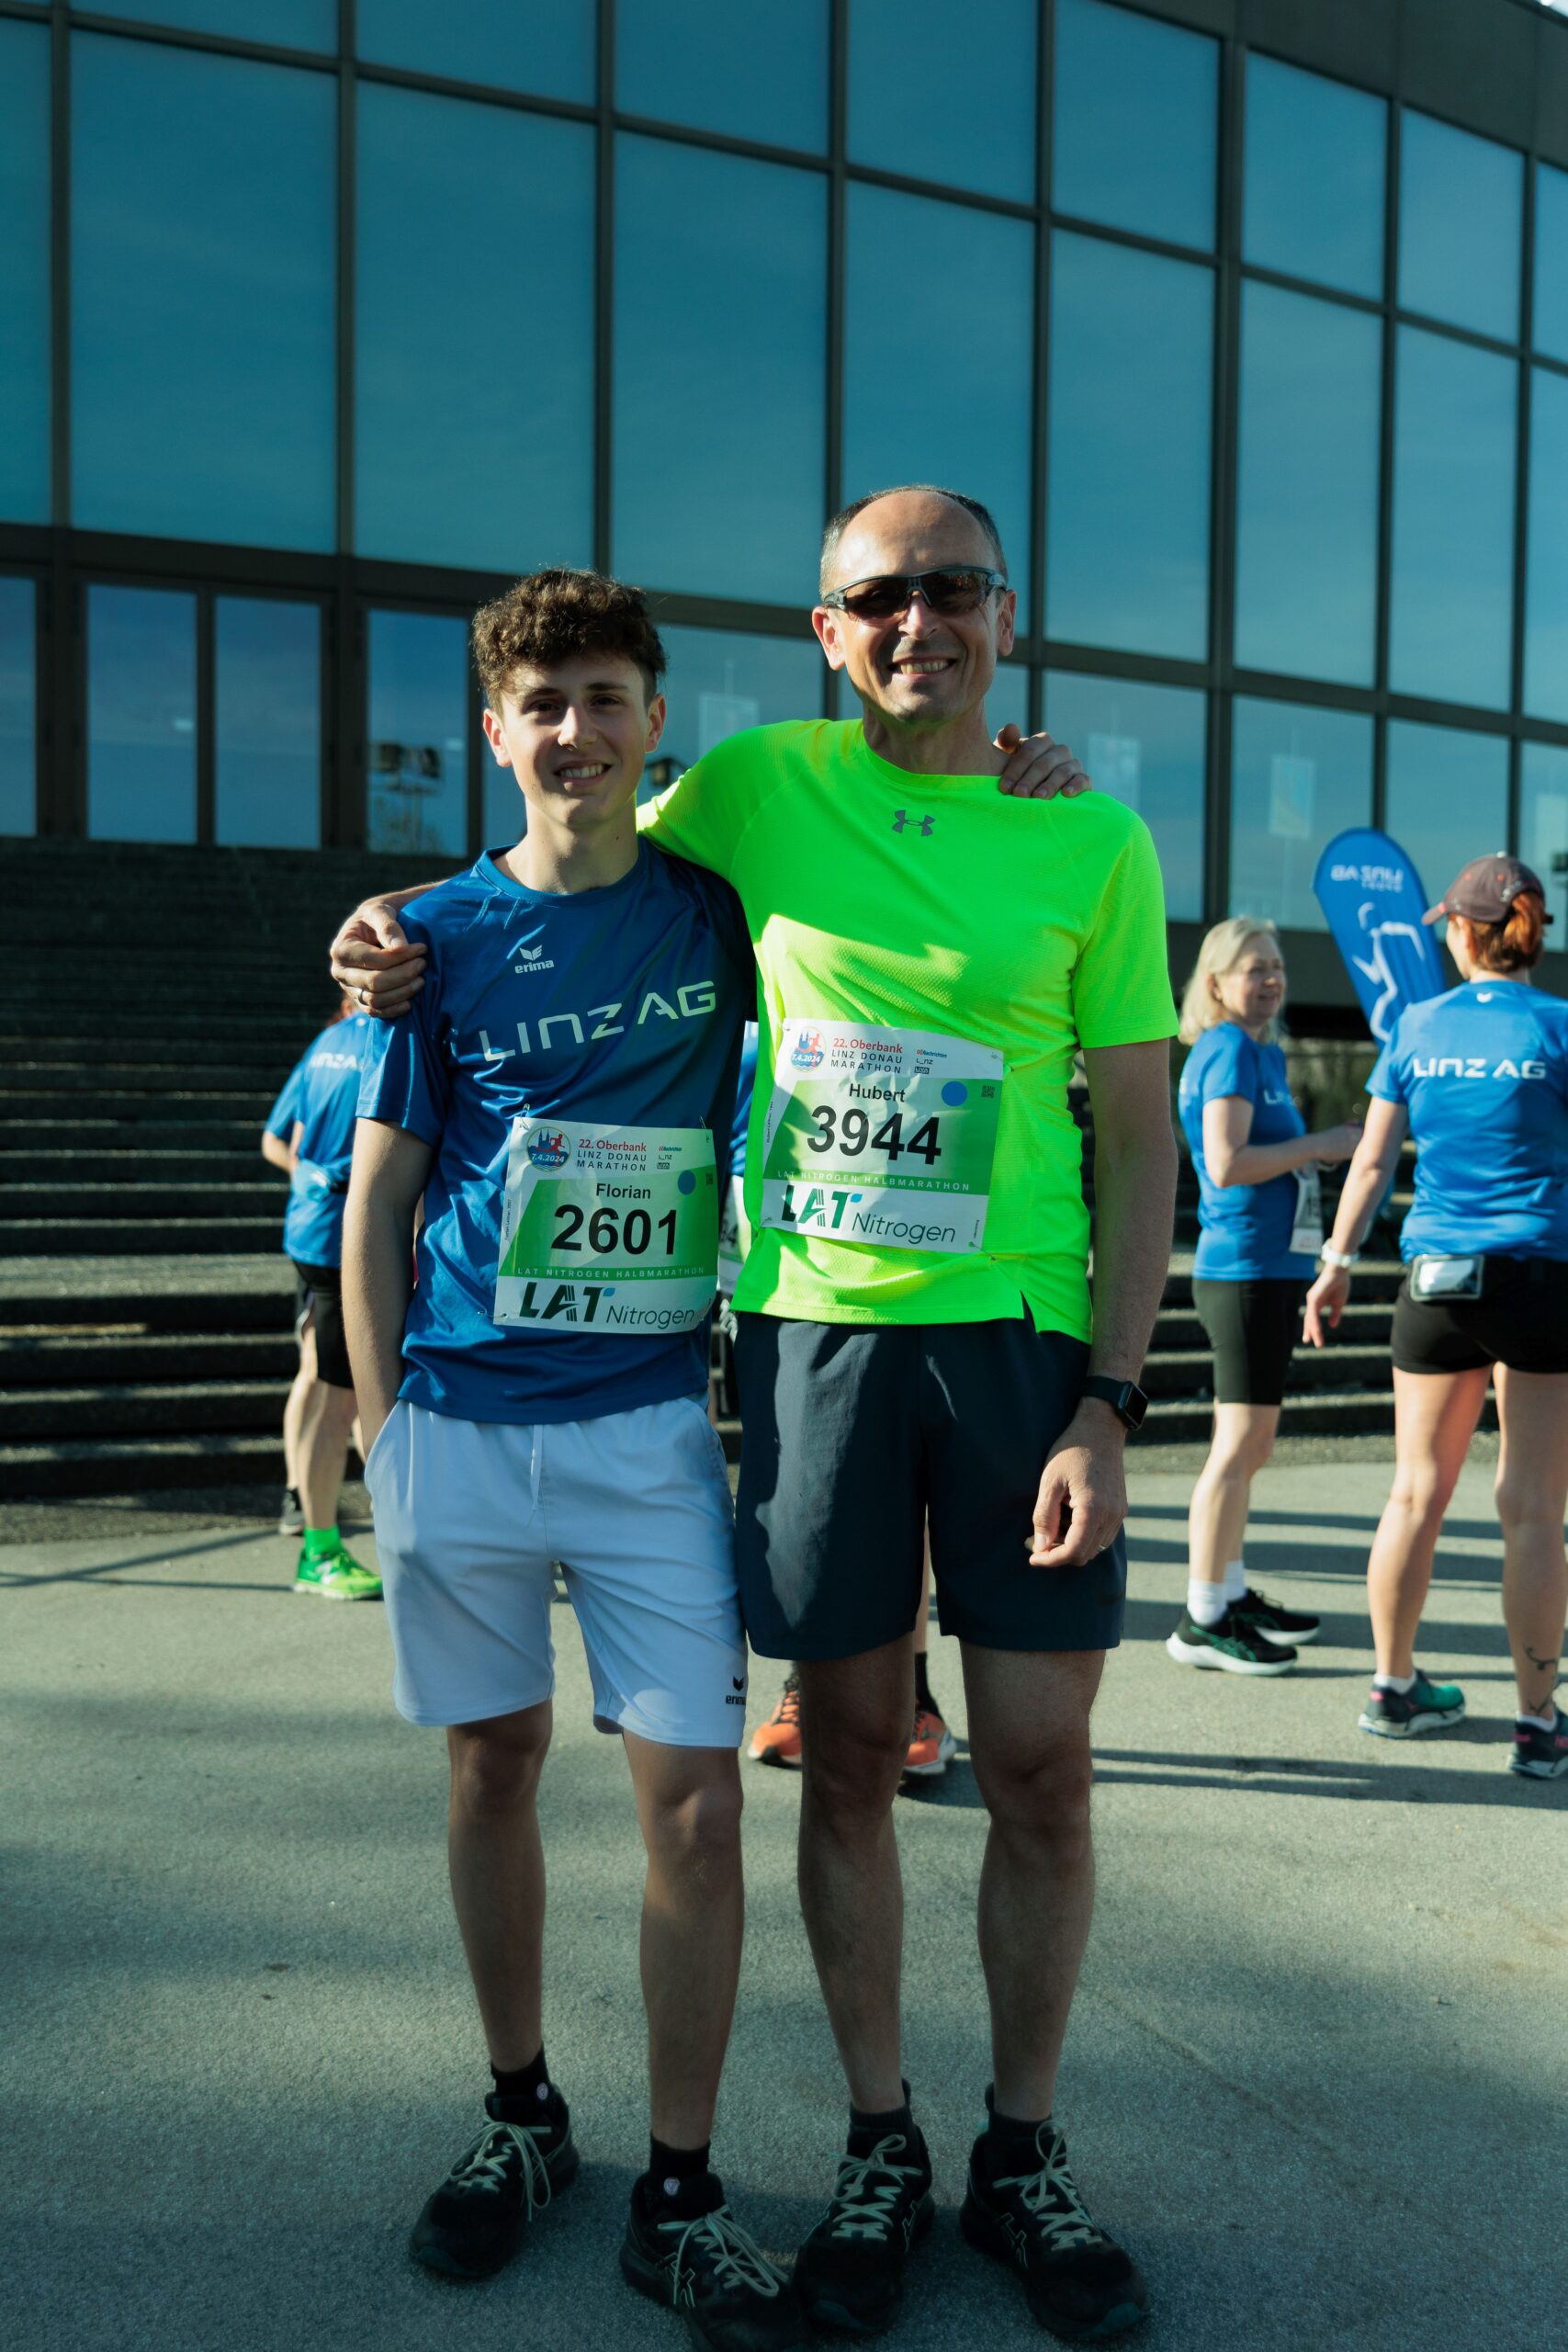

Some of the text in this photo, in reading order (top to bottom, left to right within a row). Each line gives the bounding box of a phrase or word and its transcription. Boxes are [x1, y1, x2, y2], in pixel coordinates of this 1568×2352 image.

[514, 960, 555, 974] erima
[479, 980, 716, 1062] LINZ AG
[833, 1038, 903, 1054] 22. Oberbank
[831, 1050, 903, 1065] LINZ DONAU
[830, 1059, 902, 1074] MARATHON
[1413, 1057, 1546, 1080] LINZ AG
[849, 1083, 906, 1102] Hubert
[807, 1105, 942, 1165] 3944
[579, 1139, 594, 1149] 22.
[597, 1139, 647, 1152] Oberbank
[531, 1152, 565, 1163] 7.4.2024
[577, 1150, 647, 1162] LINZ DONAU
[577, 1159, 646, 1171] MARATHON
[776, 1170, 970, 1192] LAT NITROGEN HALBMARATHON
[596, 1182, 651, 1199] Florian
[782, 1184, 852, 1229] LAT
[852, 1212, 956, 1245] Nitrogen
[551, 1204, 676, 1256] 2601
[517, 1266, 705, 1278] LAT NITROGEN HALBMARATHON
[519, 1282, 695, 1329] LAT Nitrogen
